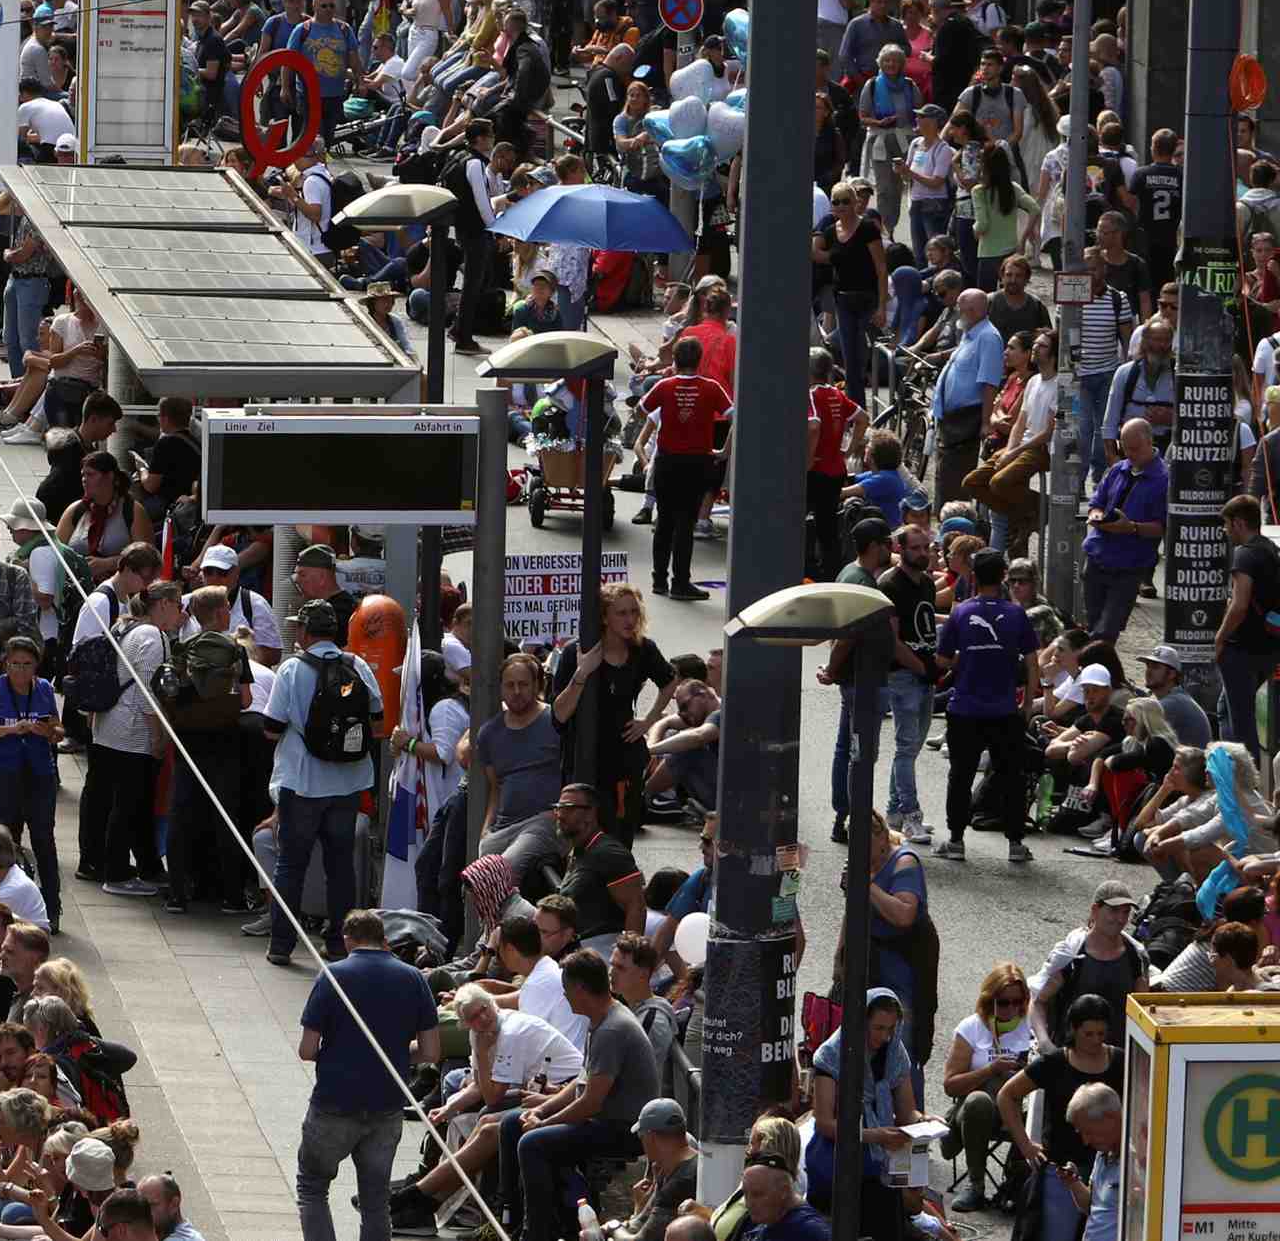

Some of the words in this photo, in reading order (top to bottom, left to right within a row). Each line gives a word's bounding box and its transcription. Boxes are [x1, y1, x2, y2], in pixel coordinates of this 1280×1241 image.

[1153, 189, 1171, 220] 2
[1184, 385, 1228, 401] RUHIG
[1179, 402, 1232, 418] BLEIBEN
[224, 422, 248, 432] Linie
[256, 422, 276, 432] Ziel
[413, 422, 449, 432] Abfahrt
[452, 422, 463, 432] in
[1181, 429, 1229, 444] DILDOS
[1180, 525, 1224, 541] RUHIG
[1175, 542, 1227, 559] BLEIBEN
[523, 554, 583, 570] VERGESSEN
[602, 553, 627, 568] OHIN
[1177, 569, 1224, 585] DILDOS
[524, 599, 544, 613] MAL
[716, 1030, 743, 1041] dich?
[712, 1046, 736, 1057] weg.
[1195, 1221, 1215, 1233] M1
[1227, 1218, 1257, 1231] Mitte
